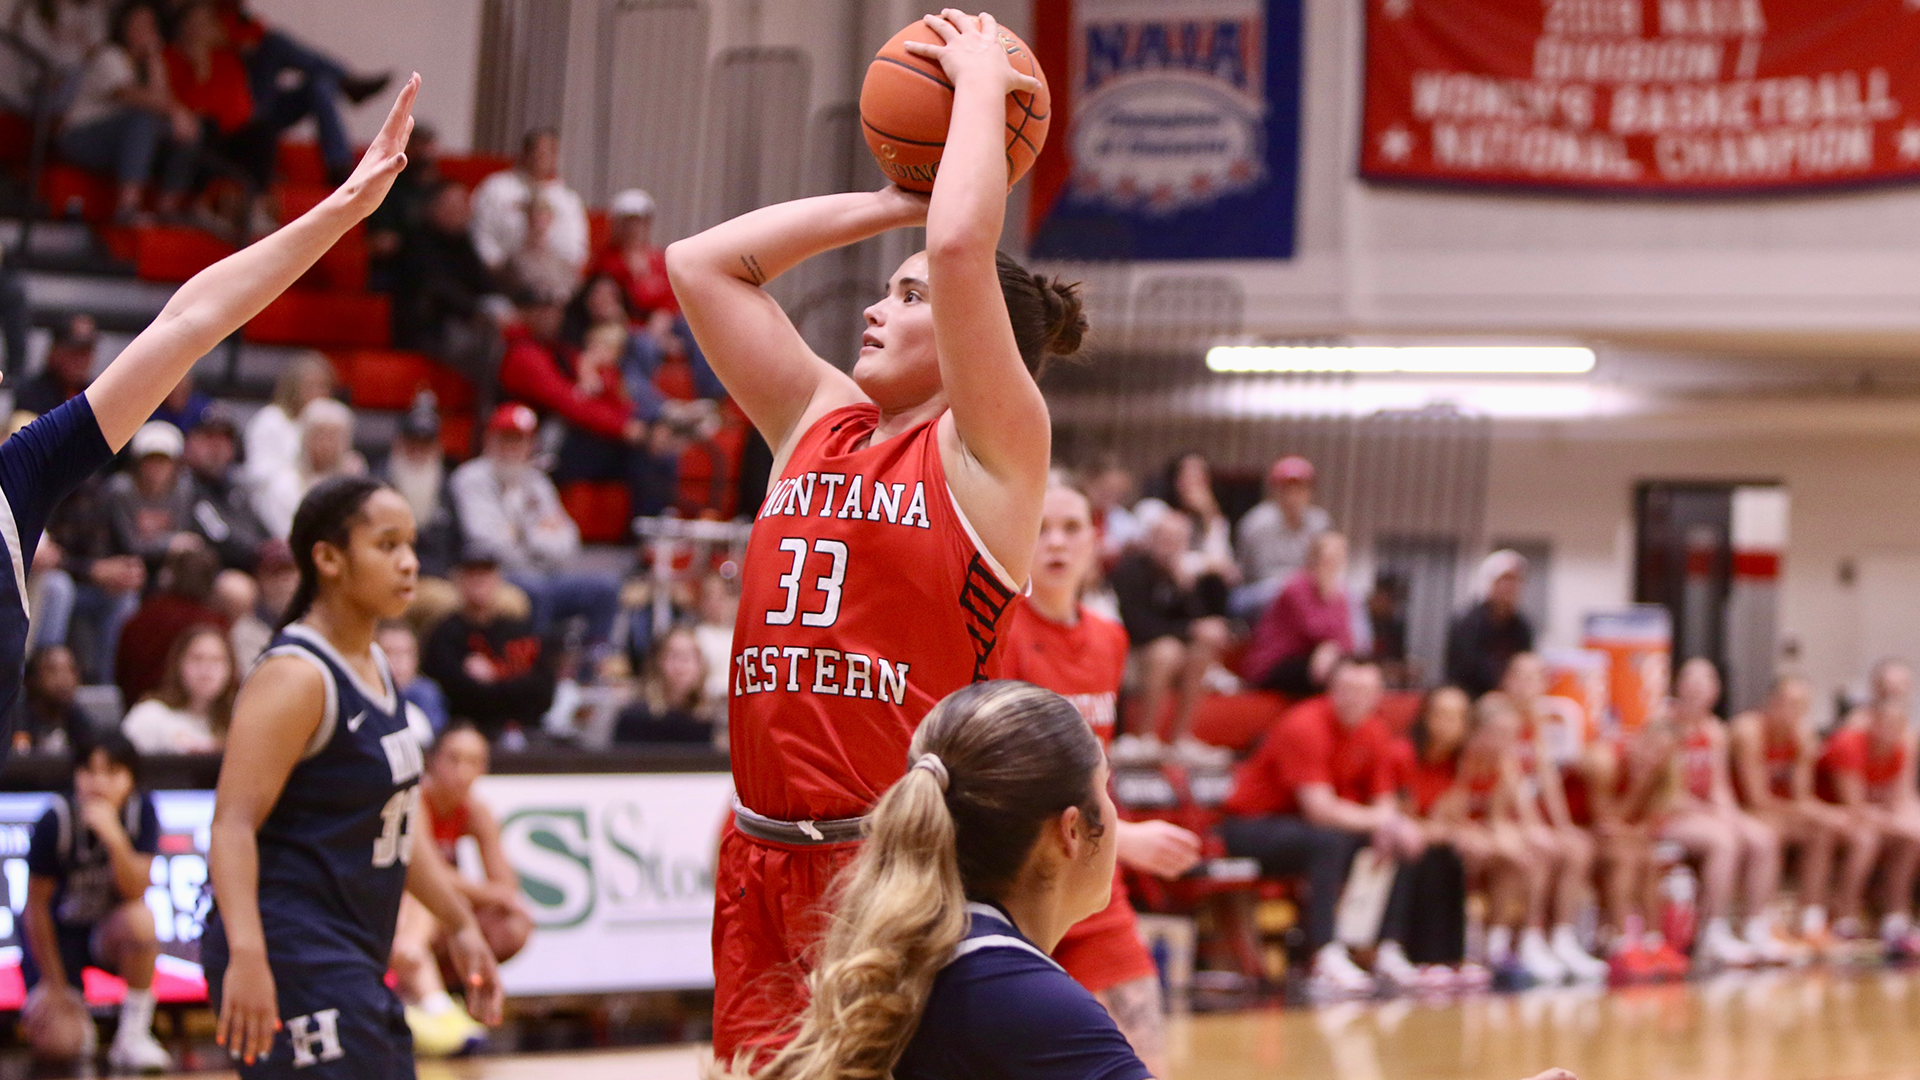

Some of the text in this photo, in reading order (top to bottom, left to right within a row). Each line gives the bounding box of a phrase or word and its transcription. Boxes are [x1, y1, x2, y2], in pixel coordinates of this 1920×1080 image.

[1085, 22, 1247, 92] NAIA
[1533, 36, 1725, 82] DIVISION
[1610, 67, 1896, 136] BASKETBALL
[1431, 120, 1874, 180] NATIONAL CHAMPION
[758, 471, 931, 529] MONTANA
[765, 537, 848, 628] 33
[285, 1008, 345, 1068] H
